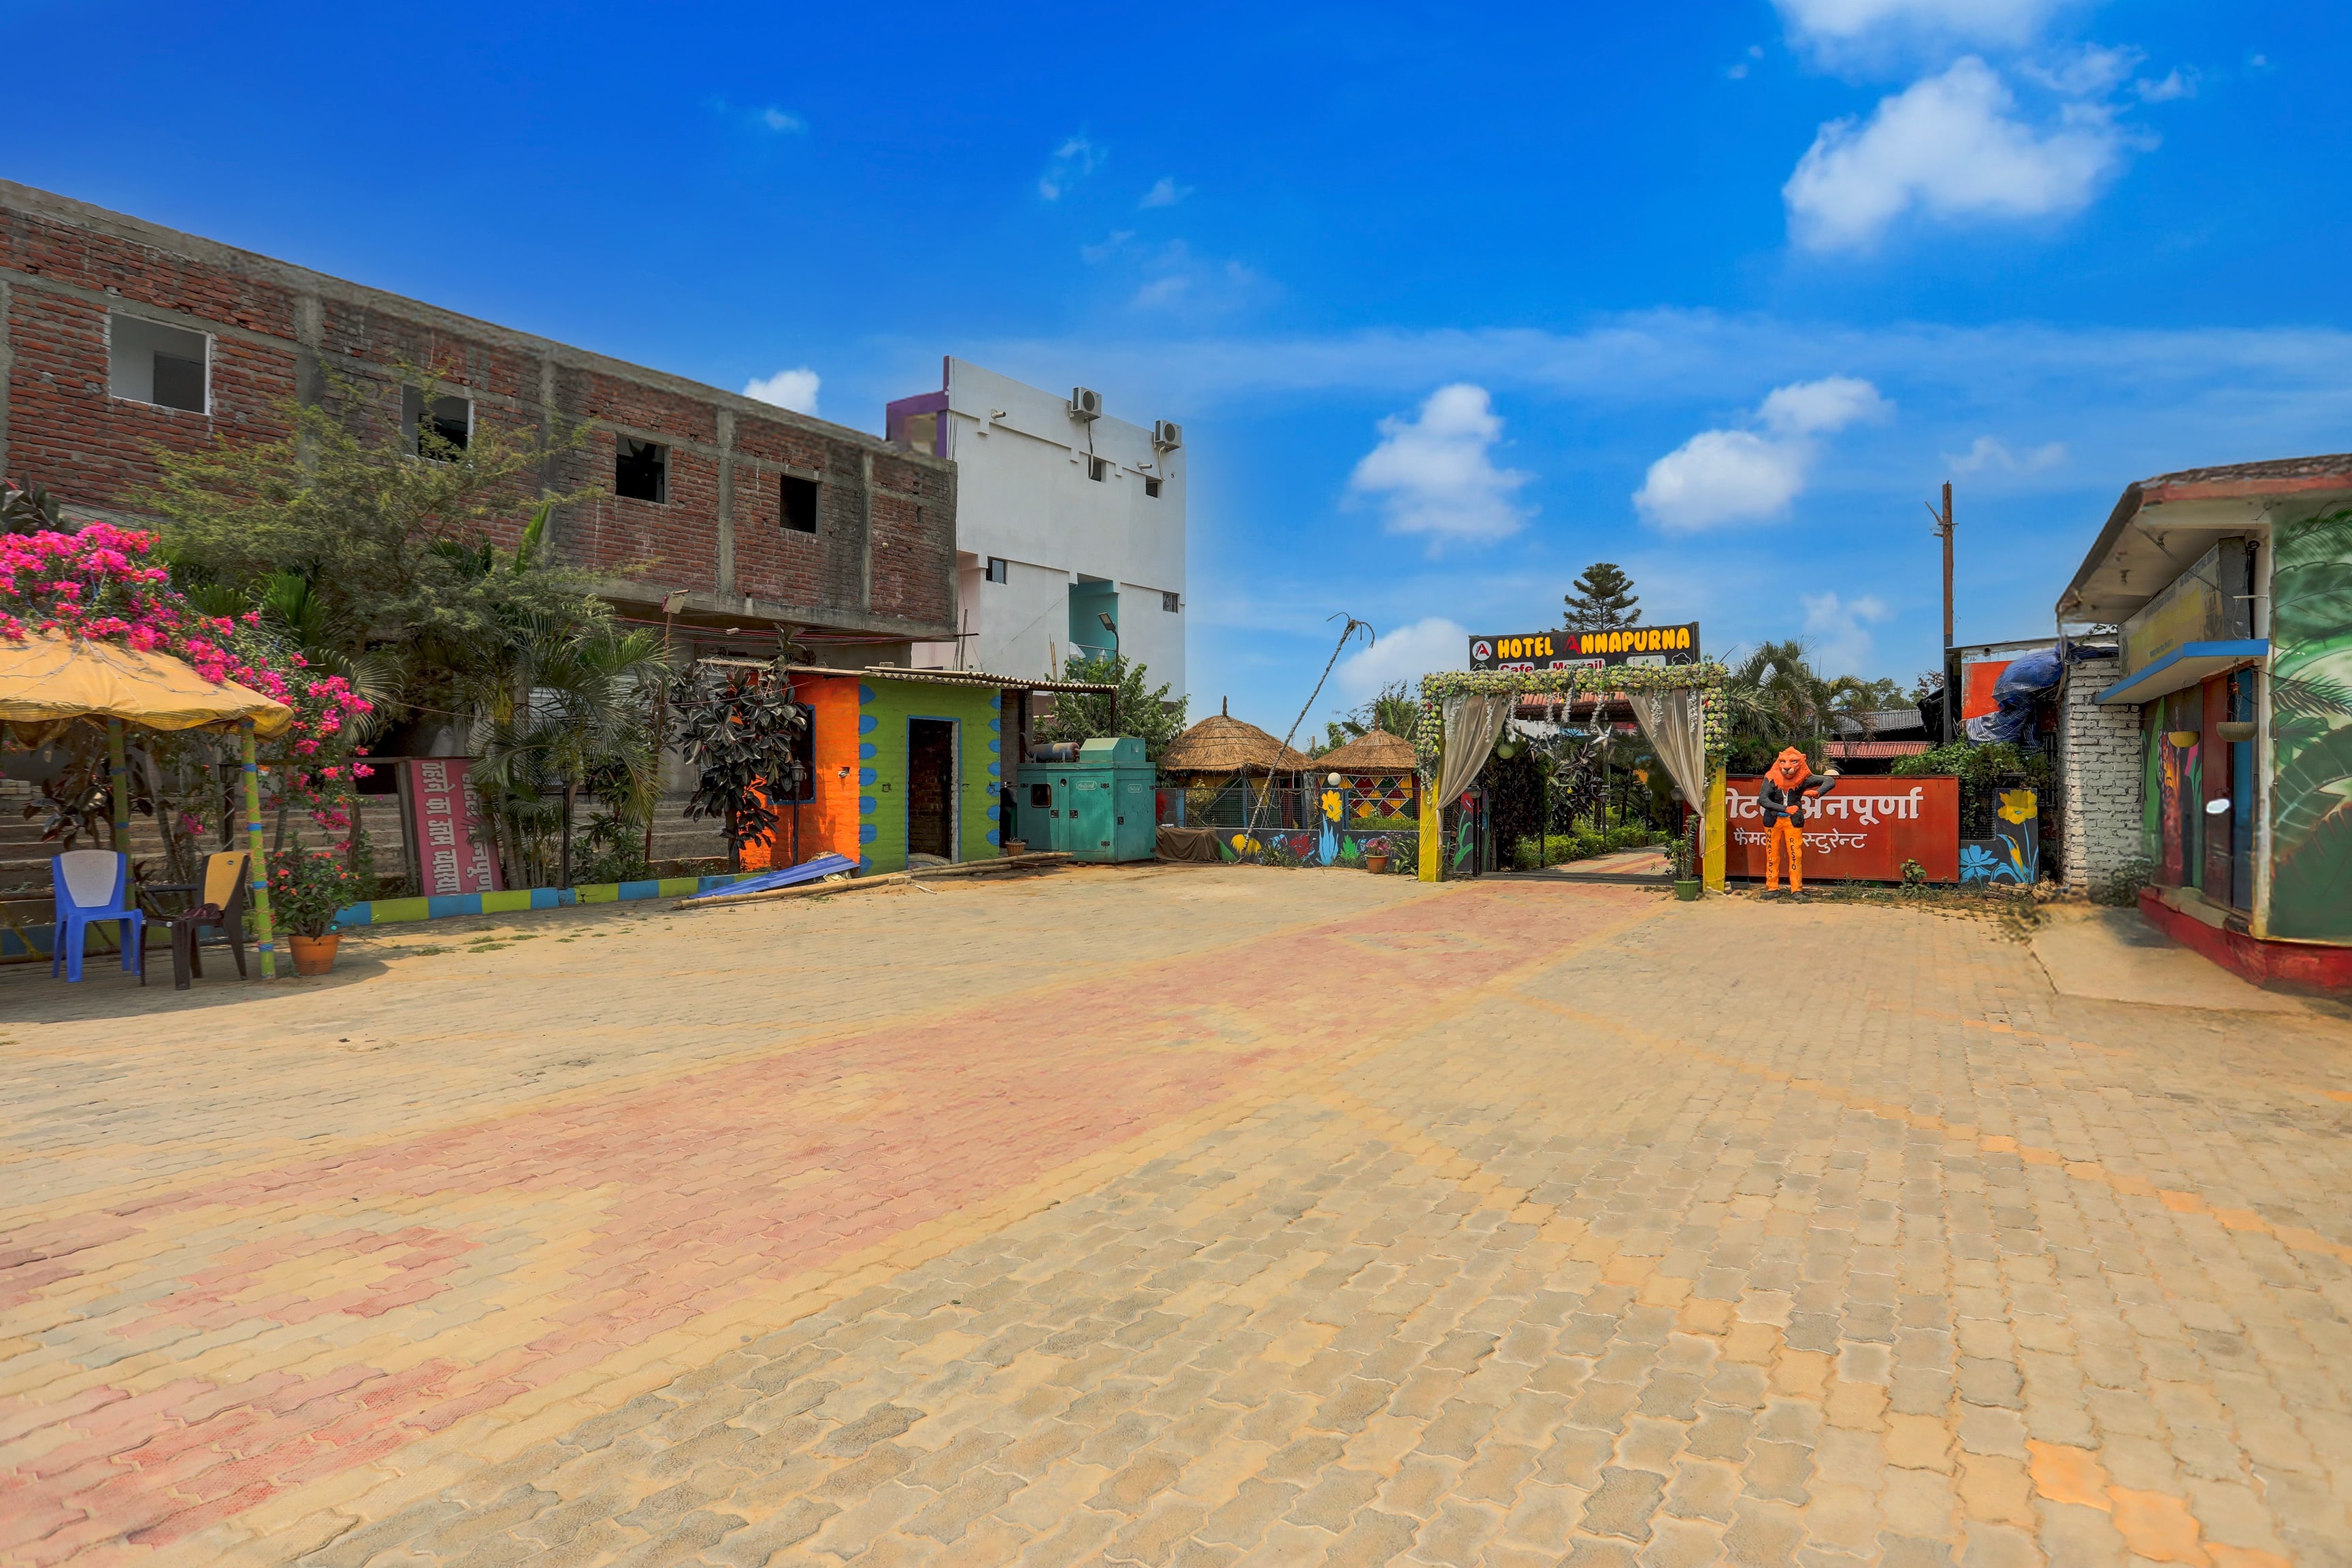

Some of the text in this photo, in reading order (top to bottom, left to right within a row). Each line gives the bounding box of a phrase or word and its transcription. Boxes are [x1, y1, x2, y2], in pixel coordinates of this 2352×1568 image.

[1497, 627, 1690, 659] HOTEL ANNAPURNA
[421, 762, 461, 893] ठहरने का उत्तम व्यवस्था
[1802, 828, 1867, 854] स्टुरेन्ट
